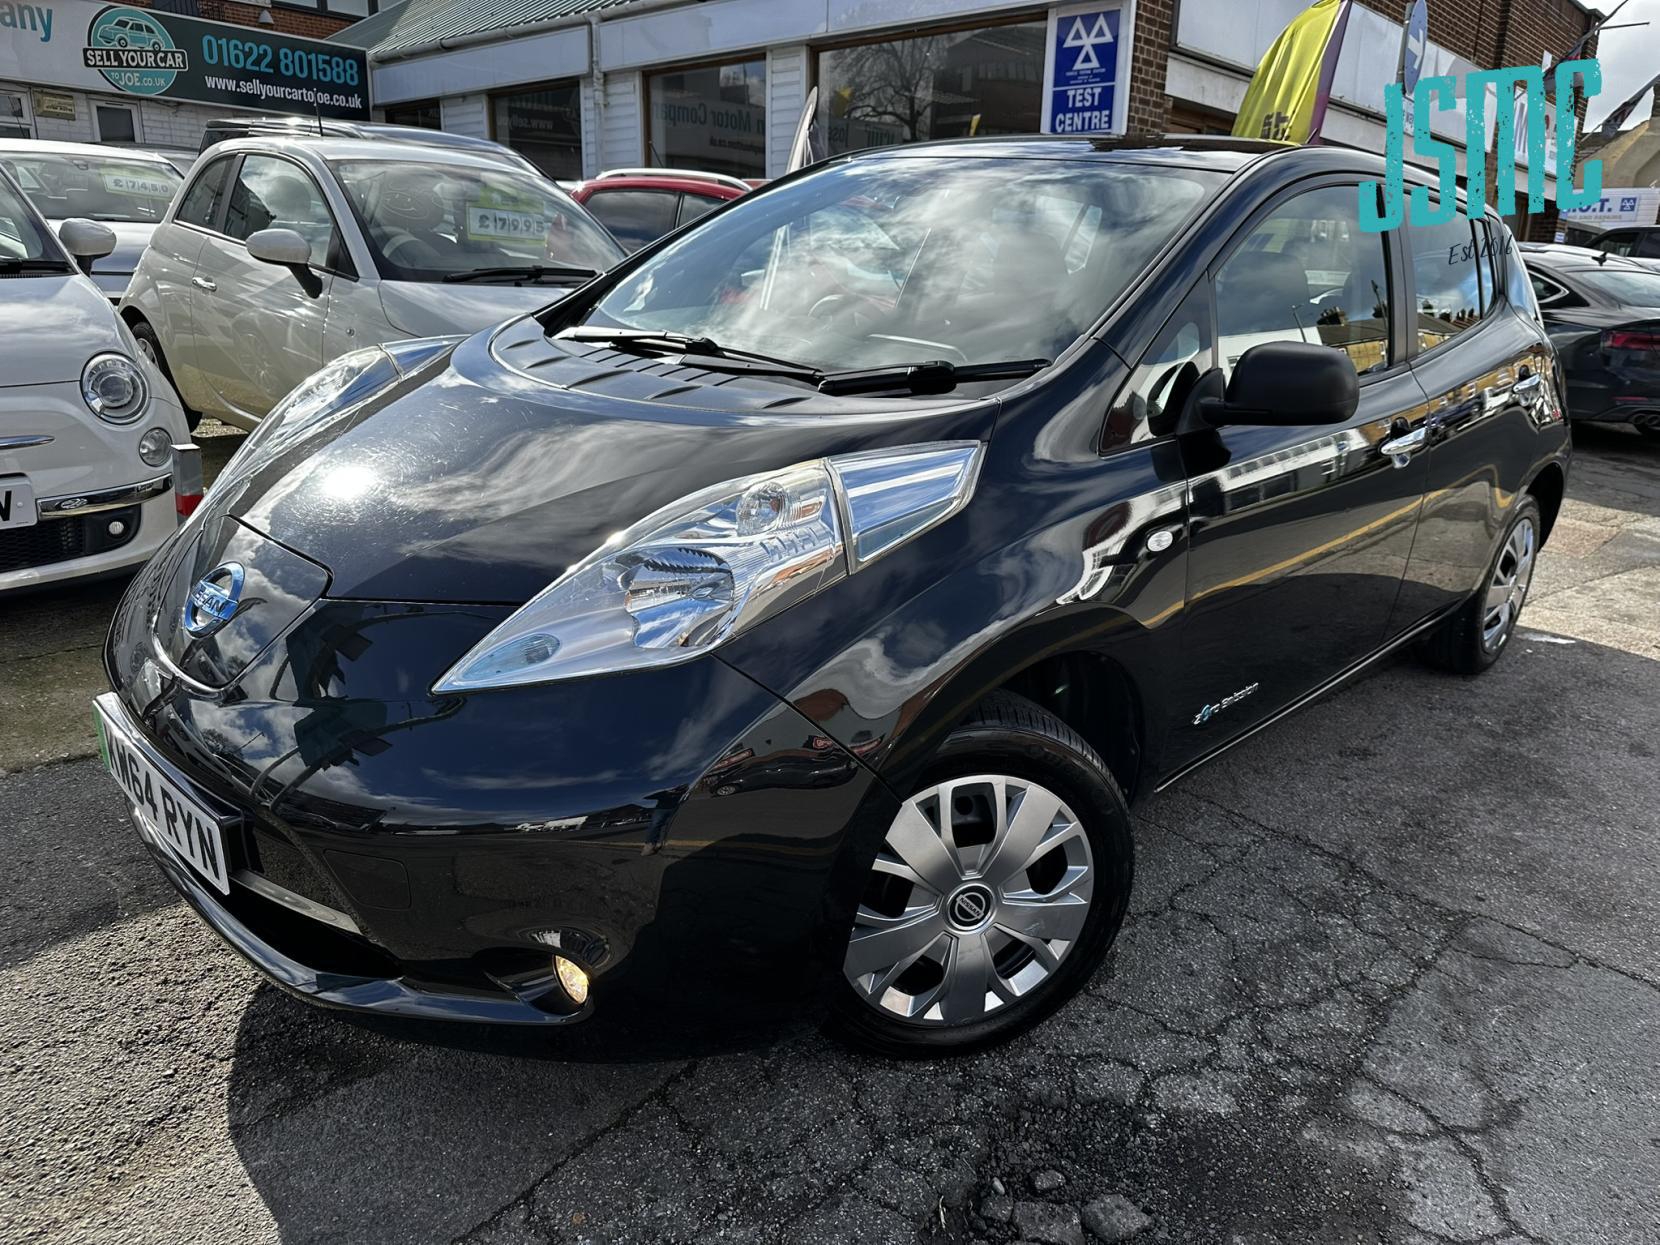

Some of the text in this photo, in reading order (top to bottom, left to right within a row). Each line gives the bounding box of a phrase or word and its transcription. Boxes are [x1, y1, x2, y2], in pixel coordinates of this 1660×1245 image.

[86, 49, 184, 67] SELL YOUR CAR
[202, 34, 359, 86] 01622 801588
[205, 75, 362, 109] www.sellyourcartojoe.co.uk
[1066, 87, 1102, 108] TEST
[1055, 110, 1110, 133] CENTRE
[160, 784, 221, 881] RYN
[960, 896, 983, 917] NISSAN
